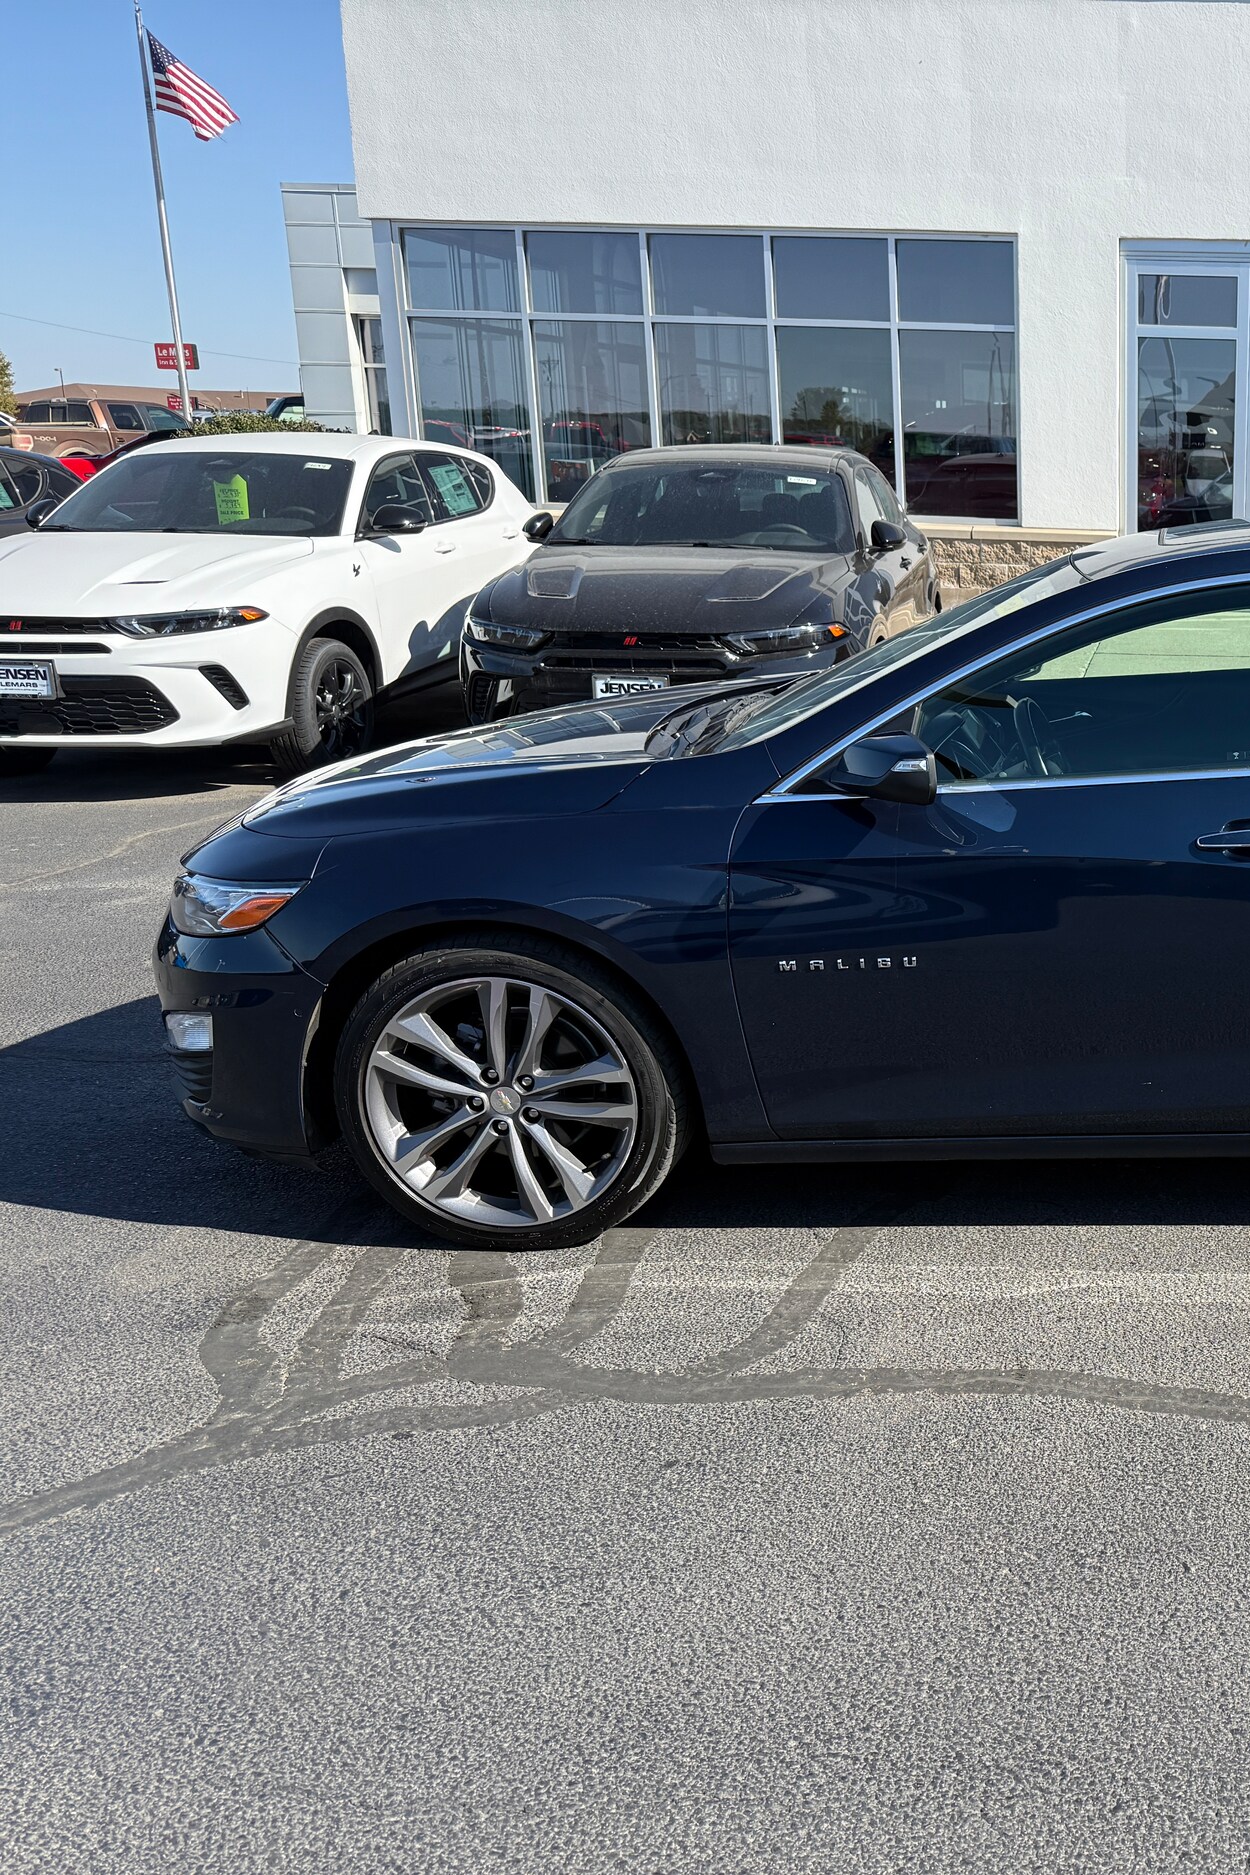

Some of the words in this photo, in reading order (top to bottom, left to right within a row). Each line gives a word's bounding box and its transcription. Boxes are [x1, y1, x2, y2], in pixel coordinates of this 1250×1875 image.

[157, 347, 168, 356] Le
[169, 347, 190, 356] Ms
[778, 956, 917, 972] MALIBU
